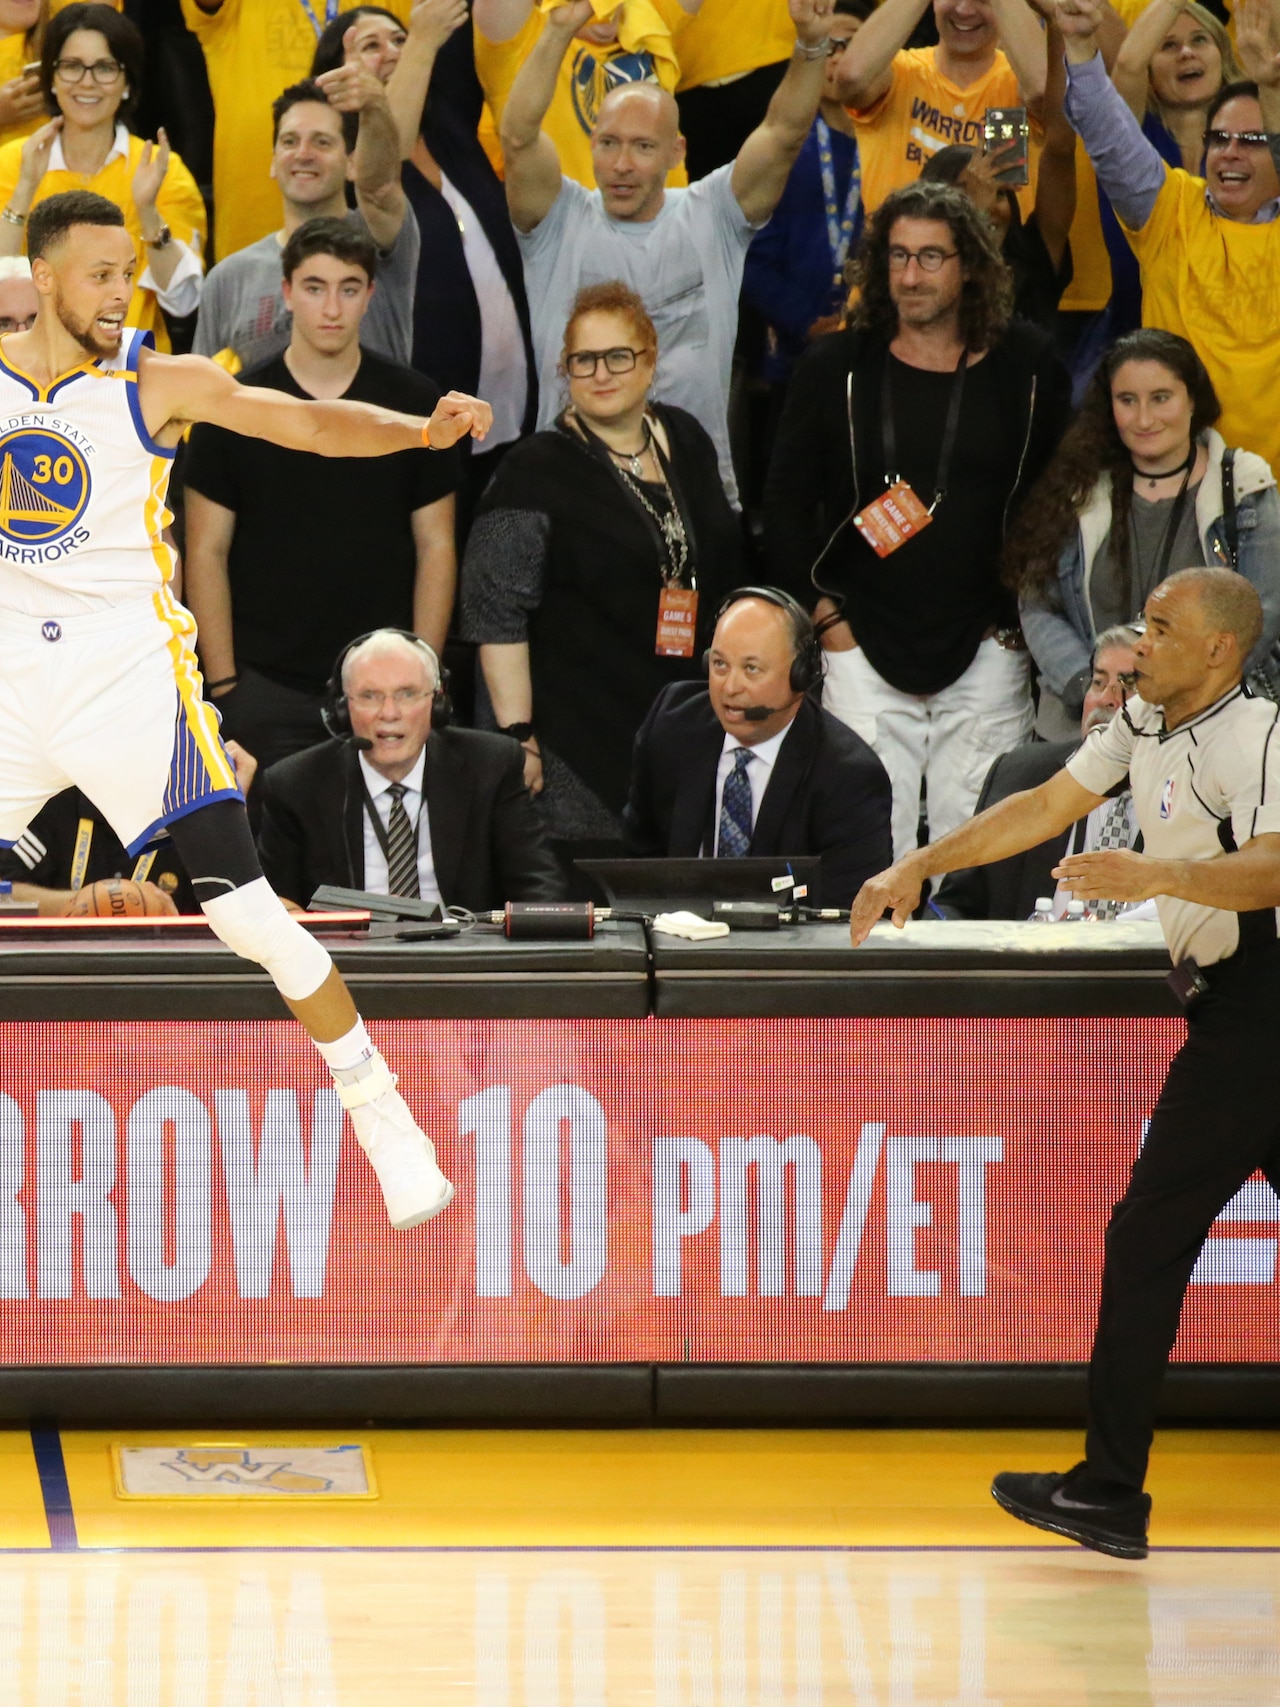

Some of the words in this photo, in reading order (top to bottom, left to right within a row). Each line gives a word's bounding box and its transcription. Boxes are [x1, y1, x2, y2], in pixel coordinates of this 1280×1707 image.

[51, 419, 96, 457] STATE
[31, 454, 74, 485] 30
[883, 498, 907, 526] GAME
[663, 610, 686, 623] GAME
[43, 626, 59, 638] W
[457, 1083, 608, 1301] 10
